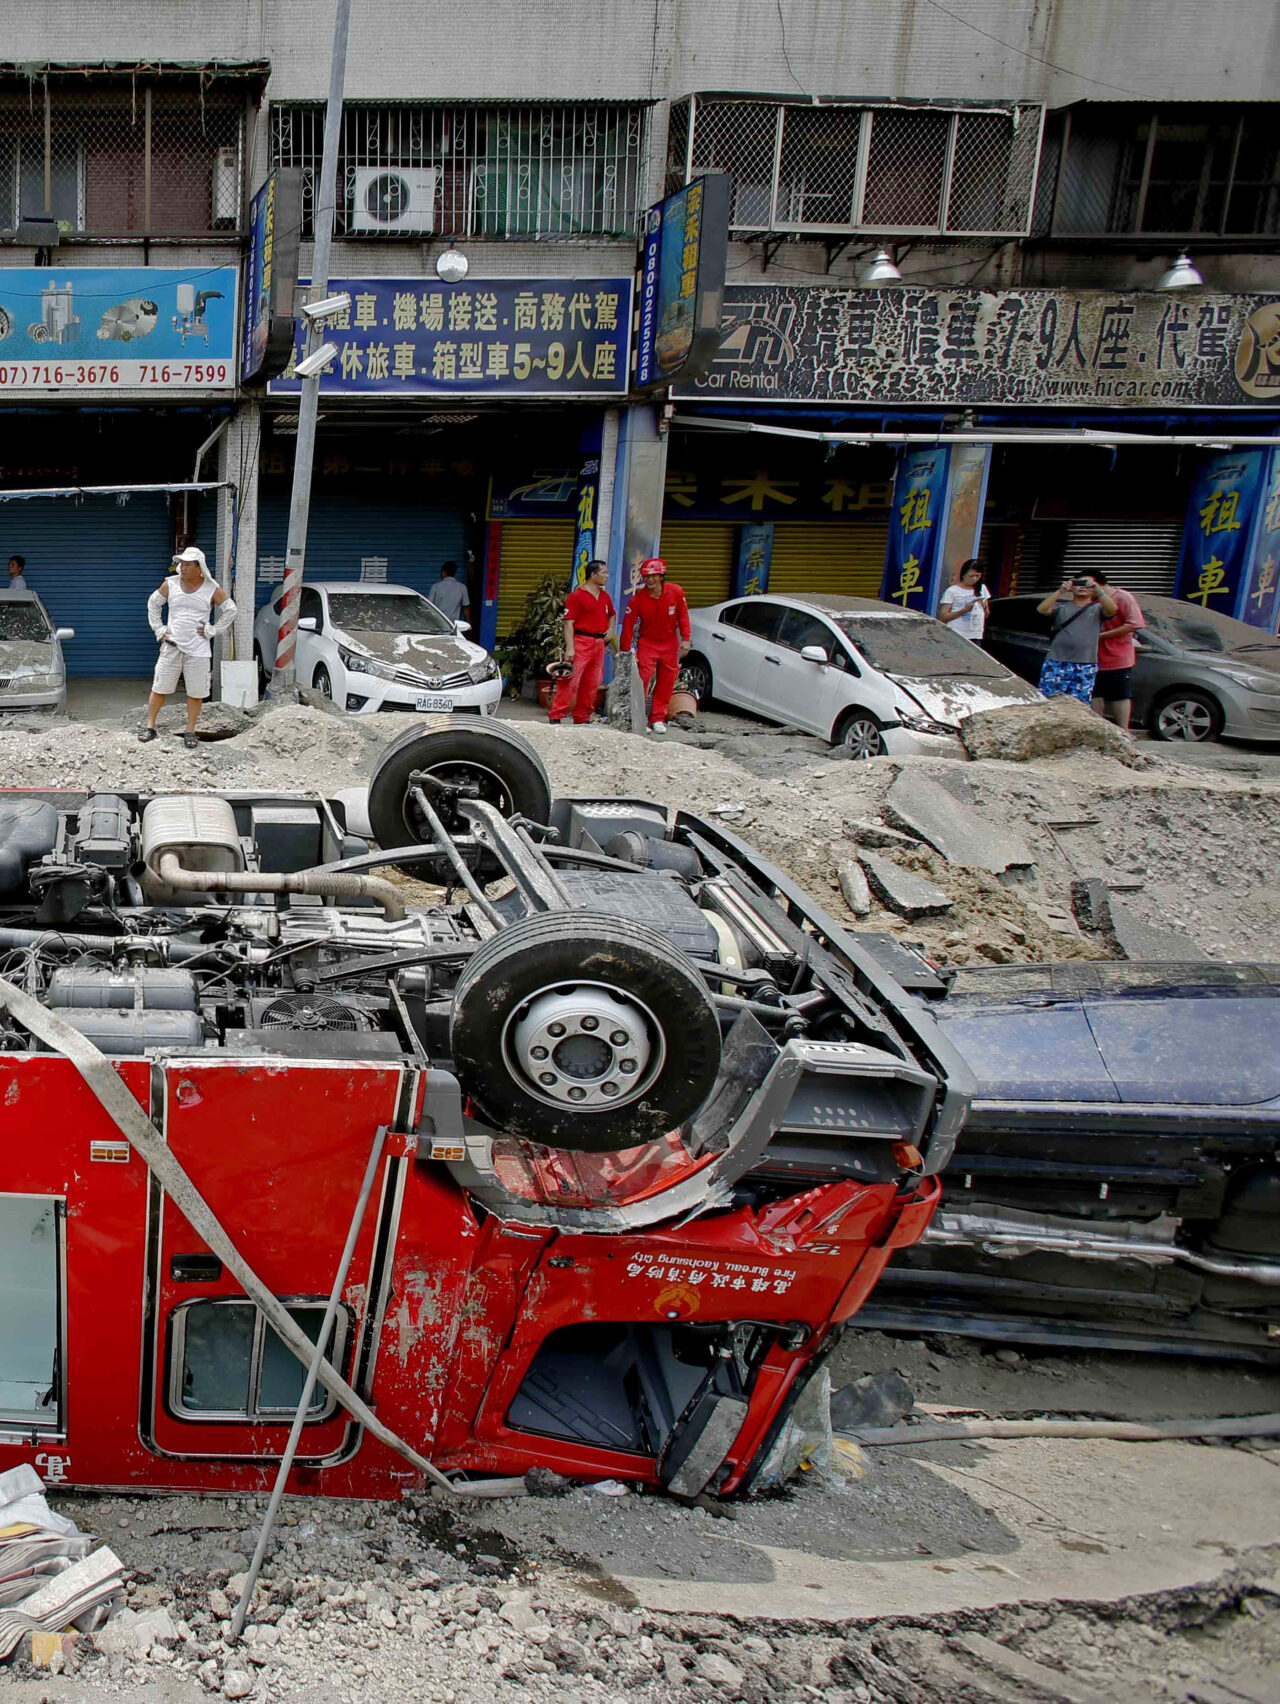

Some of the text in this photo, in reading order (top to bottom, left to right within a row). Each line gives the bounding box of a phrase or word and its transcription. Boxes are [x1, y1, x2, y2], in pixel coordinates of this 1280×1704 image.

[640, 243, 657, 381] 0800225228
[138, 364, 227, 384] 716-7599
[695, 370, 779, 390] Car Rental
[891, 486, 933, 607] 租車
[1187, 488, 1242, 607] 租車
[631, 1251, 654, 1264] City
[658, 1253, 720, 1271] Kaohsiung
[626, 1263, 792, 1295] 高雄市政府消防局
[774, 1268, 796, 1281] Fire
